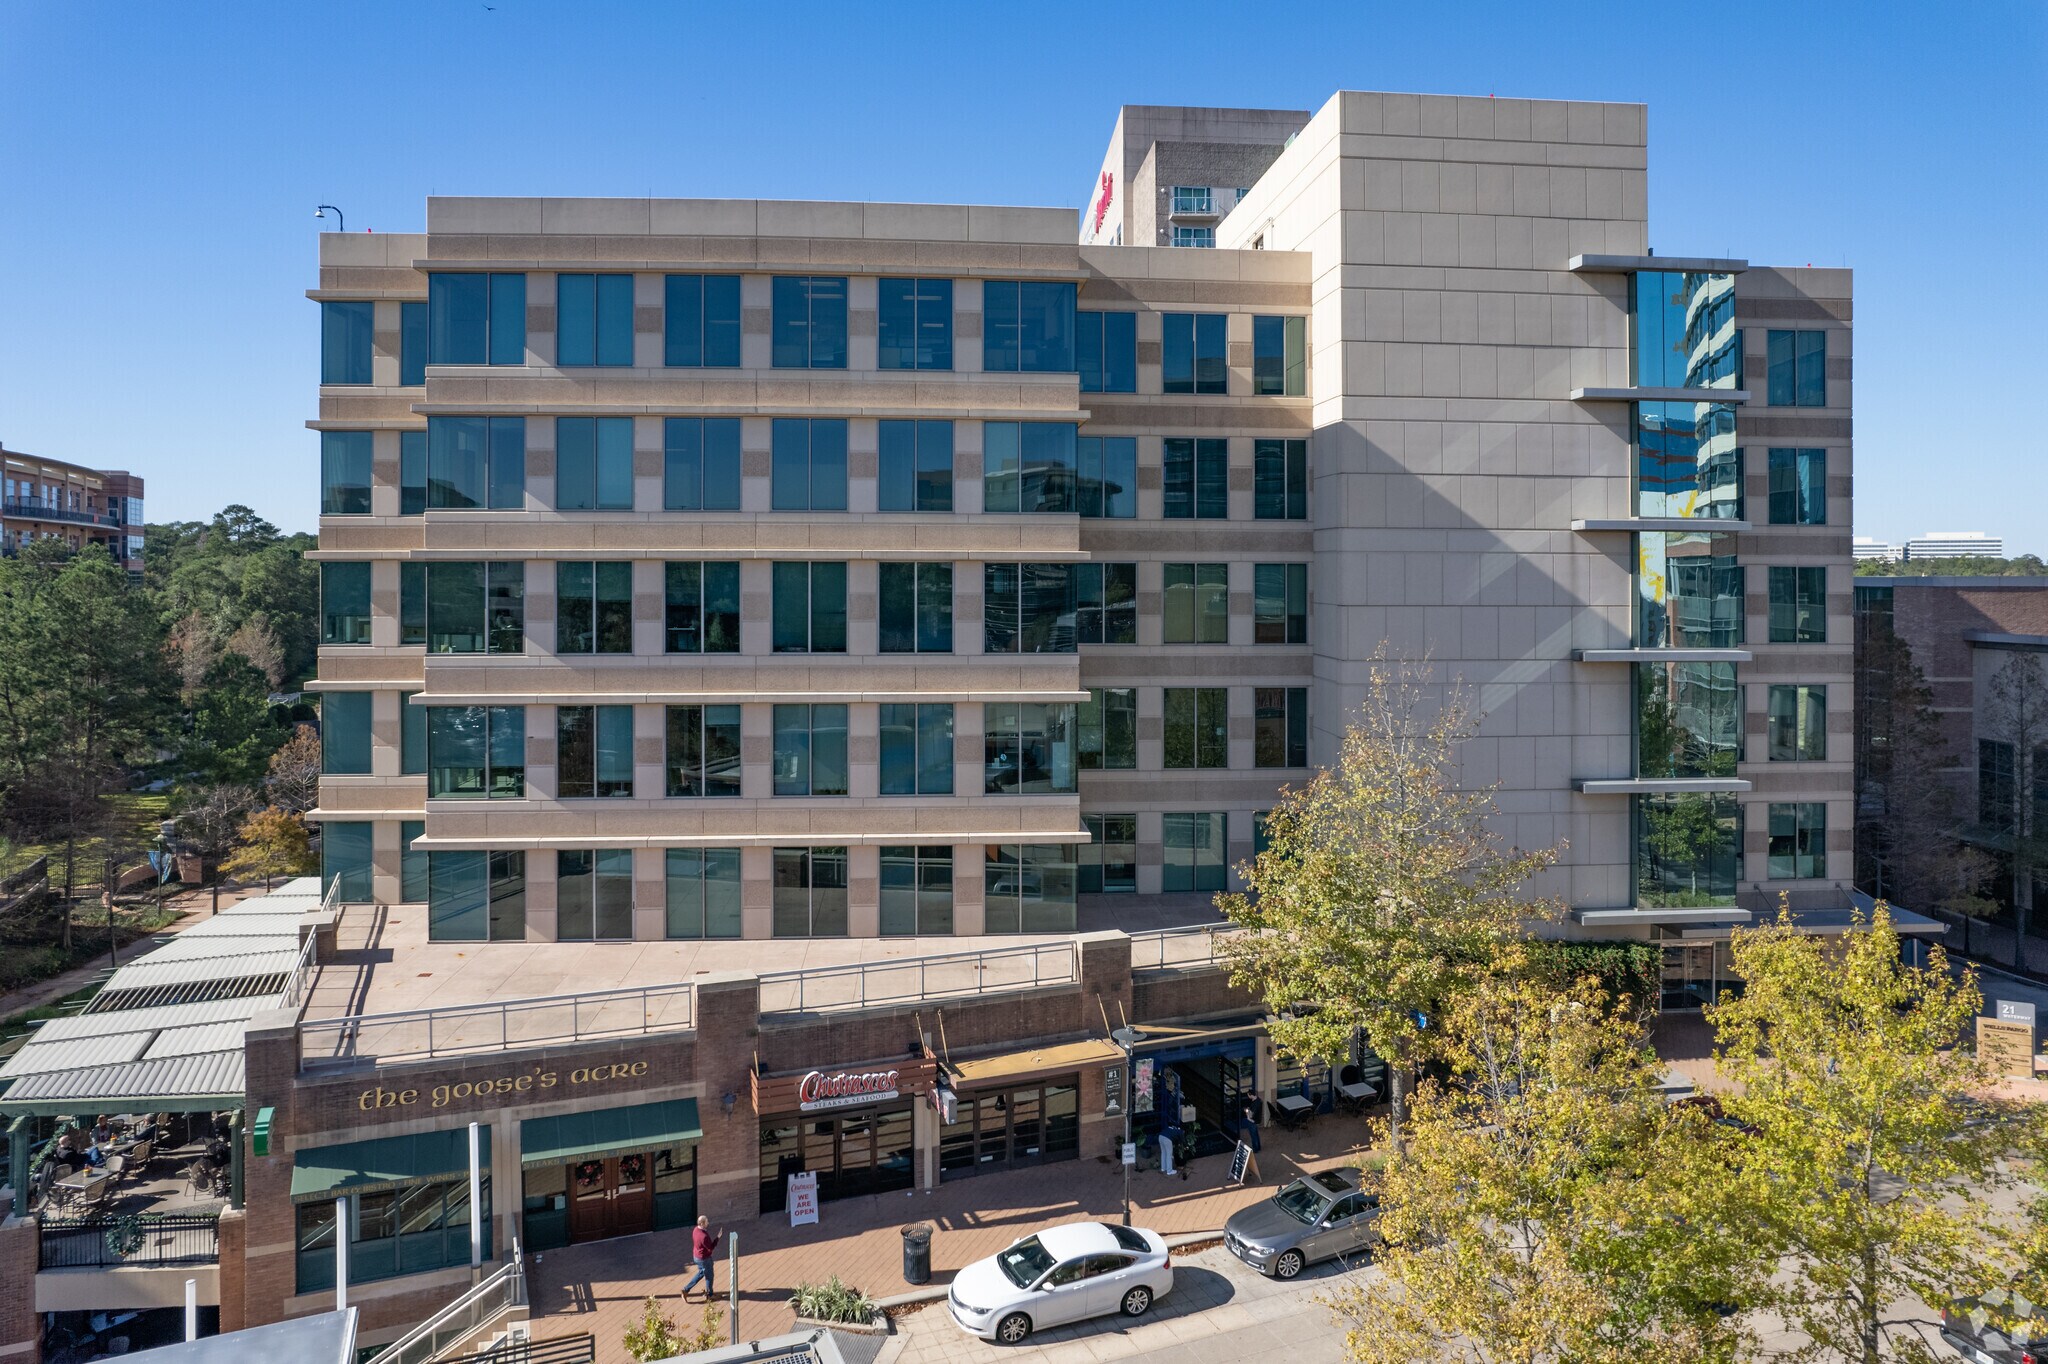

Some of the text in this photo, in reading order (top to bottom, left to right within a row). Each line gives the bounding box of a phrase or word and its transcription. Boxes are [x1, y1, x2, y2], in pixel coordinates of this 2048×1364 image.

[2002, 1004, 2015, 1014] 21
[357, 1061, 648, 1110] the goose's acre
[813, 1101, 842, 1109] STEAKS
[851, 1094, 886, 1103] SEAFOOD
[294, 1191, 327, 1202] SELECT
[331, 1188, 349, 1197] BAR
[362, 1182, 395, 1193] BISTRO
[404, 1178, 421, 1186] FINE
[426, 1173, 455, 1183] WINES
[795, 1208, 814, 1216] OPEN
